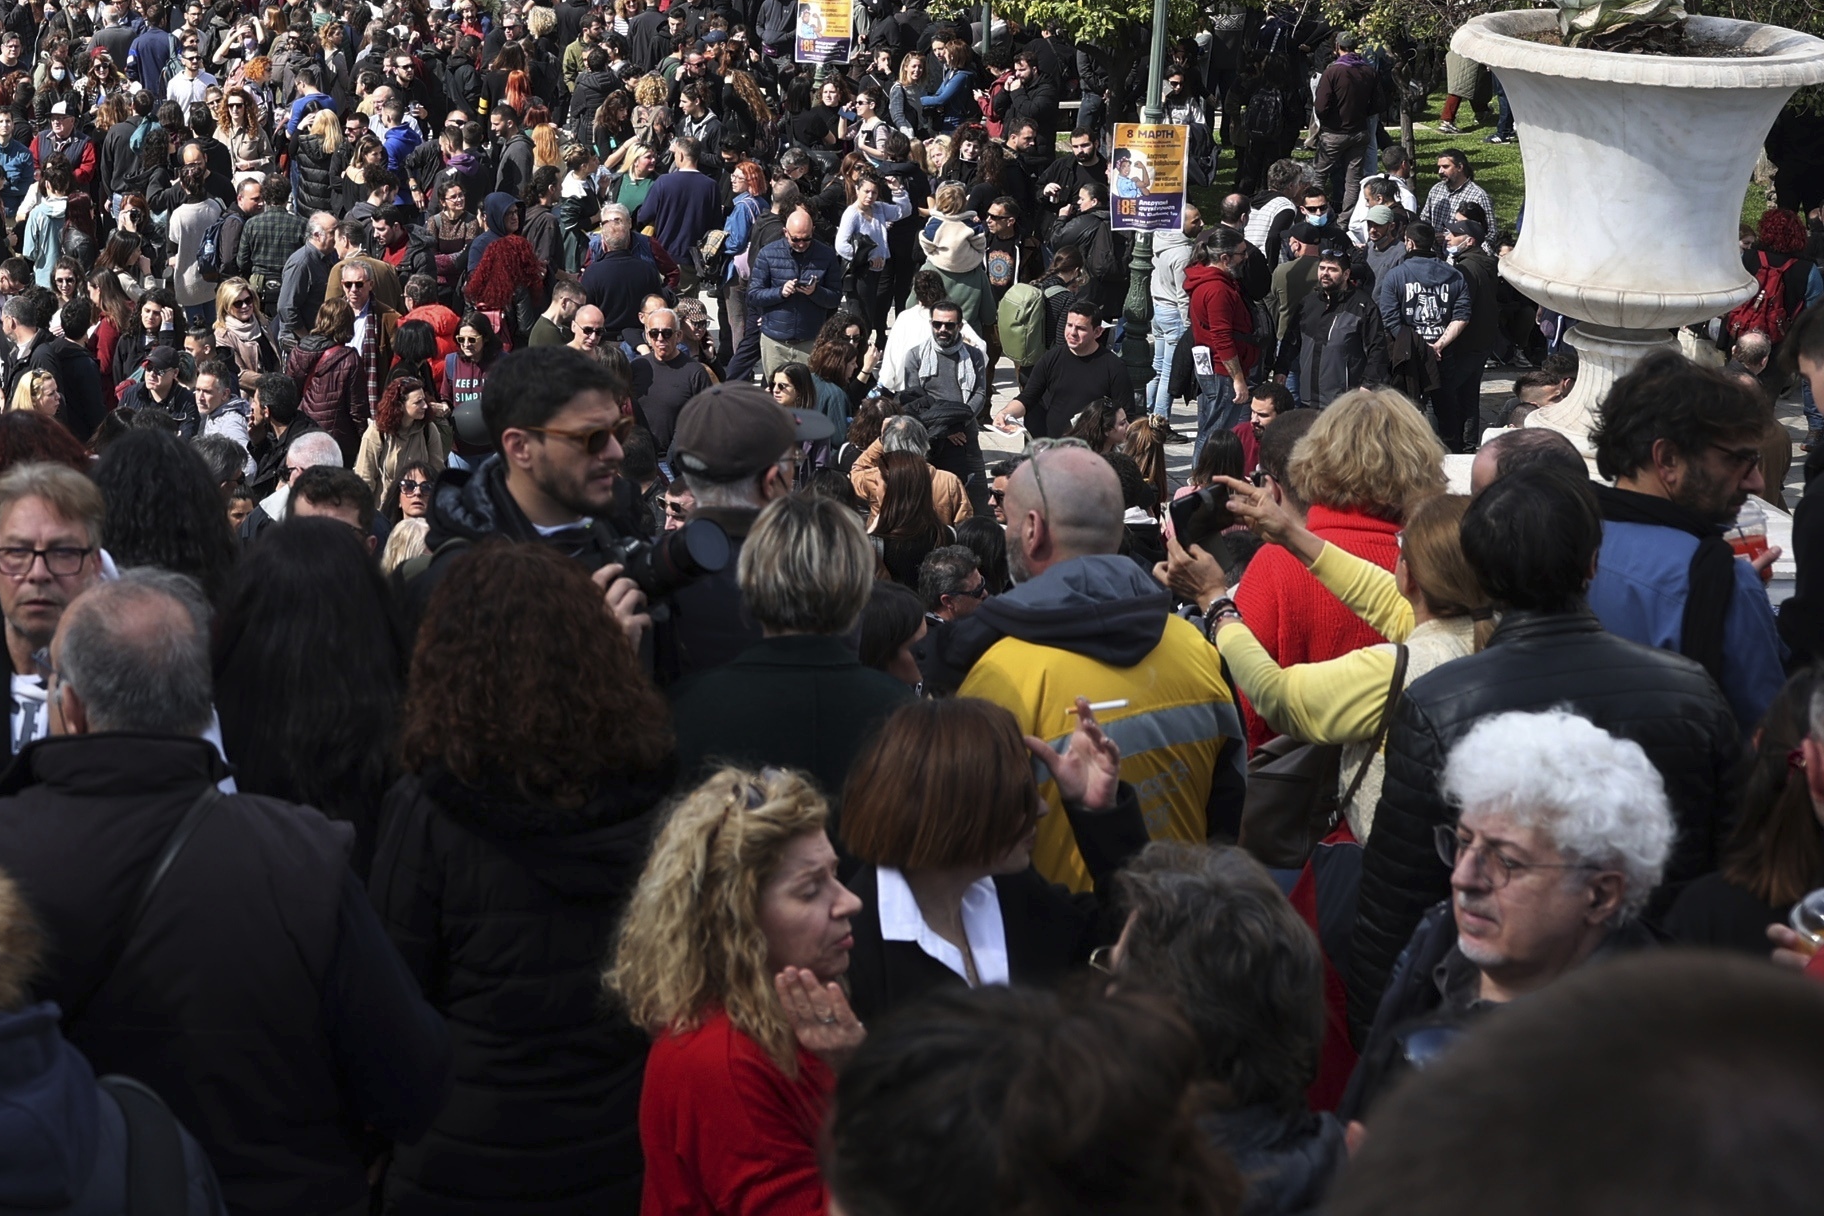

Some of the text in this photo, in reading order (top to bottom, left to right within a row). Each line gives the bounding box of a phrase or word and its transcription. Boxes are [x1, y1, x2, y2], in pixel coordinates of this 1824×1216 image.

[1127, 129, 1174, 139] 8 ΜΑΡΤΗ
[1121, 199, 1130, 215] 8
[455, 378, 479, 389] KEEP
